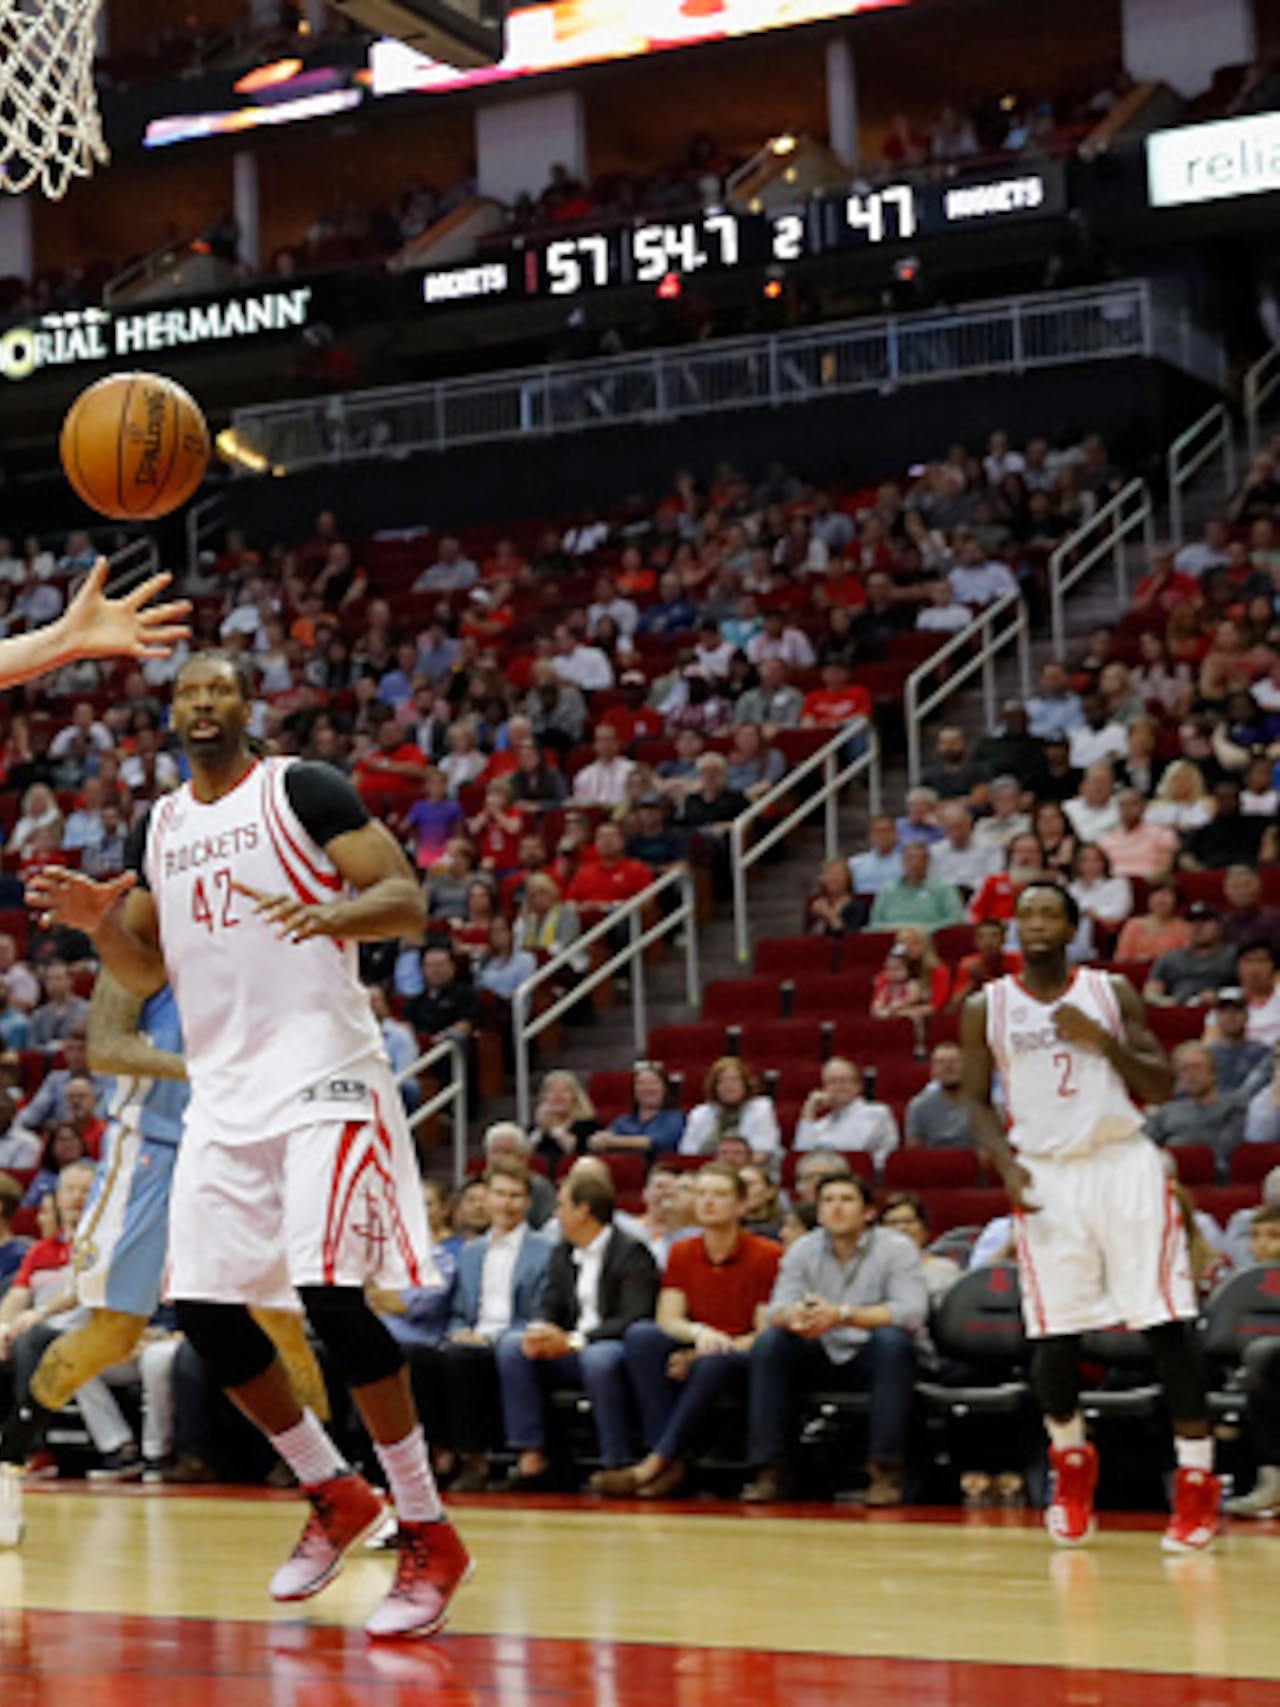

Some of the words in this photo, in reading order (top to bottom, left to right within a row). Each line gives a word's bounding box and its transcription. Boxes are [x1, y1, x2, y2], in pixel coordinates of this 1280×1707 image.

[546, 236, 608, 295] 57
[634, 214, 739, 281] 54.7
[773, 215, 804, 260] 2
[846, 185, 917, 242] 47
[115, 287, 312, 355] HERMANN
[166, 822, 259, 879] ROCKETS
[191, 865, 240, 934] 42
[1053, 1051, 1078, 1097] 2
